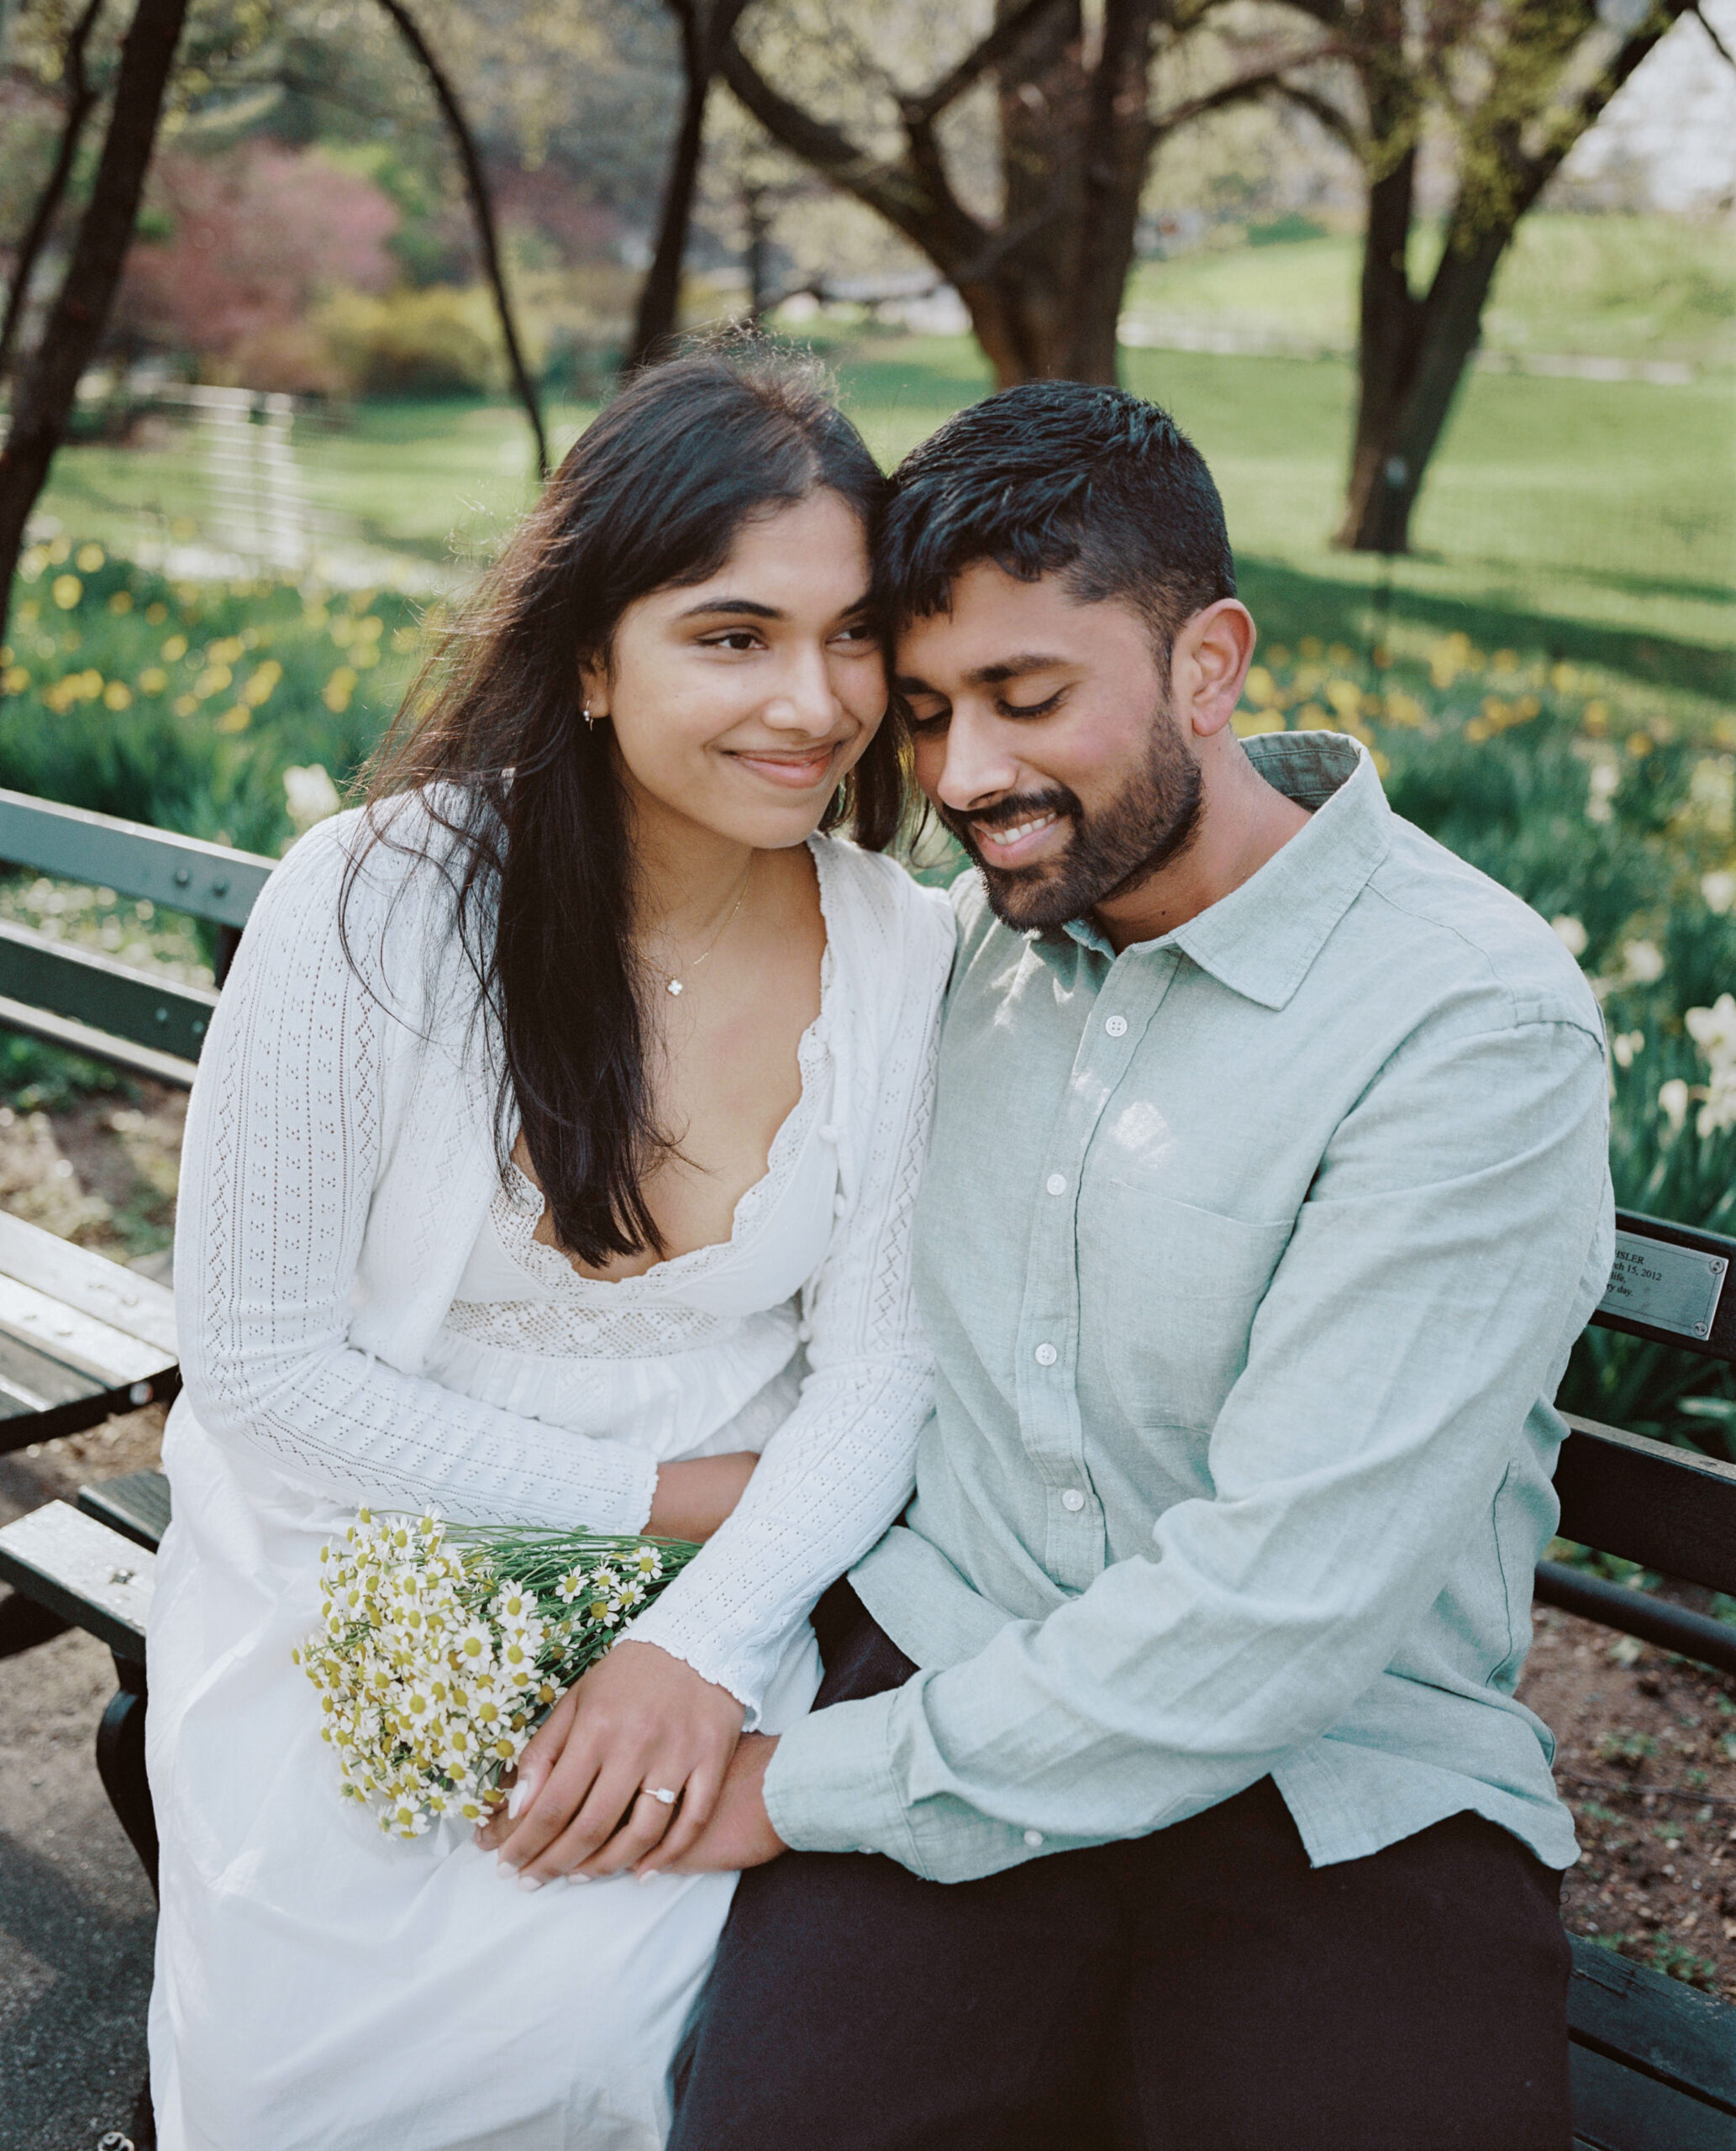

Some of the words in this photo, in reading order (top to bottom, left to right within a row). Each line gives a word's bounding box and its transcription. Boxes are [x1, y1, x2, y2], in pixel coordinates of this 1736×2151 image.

[1610, 1271, 1626, 1283] life,
[1627, 1265, 1639, 1276] 15,
[1641, 1269, 1662, 1281] 2012
[1617, 1286, 1633, 1297] day.
